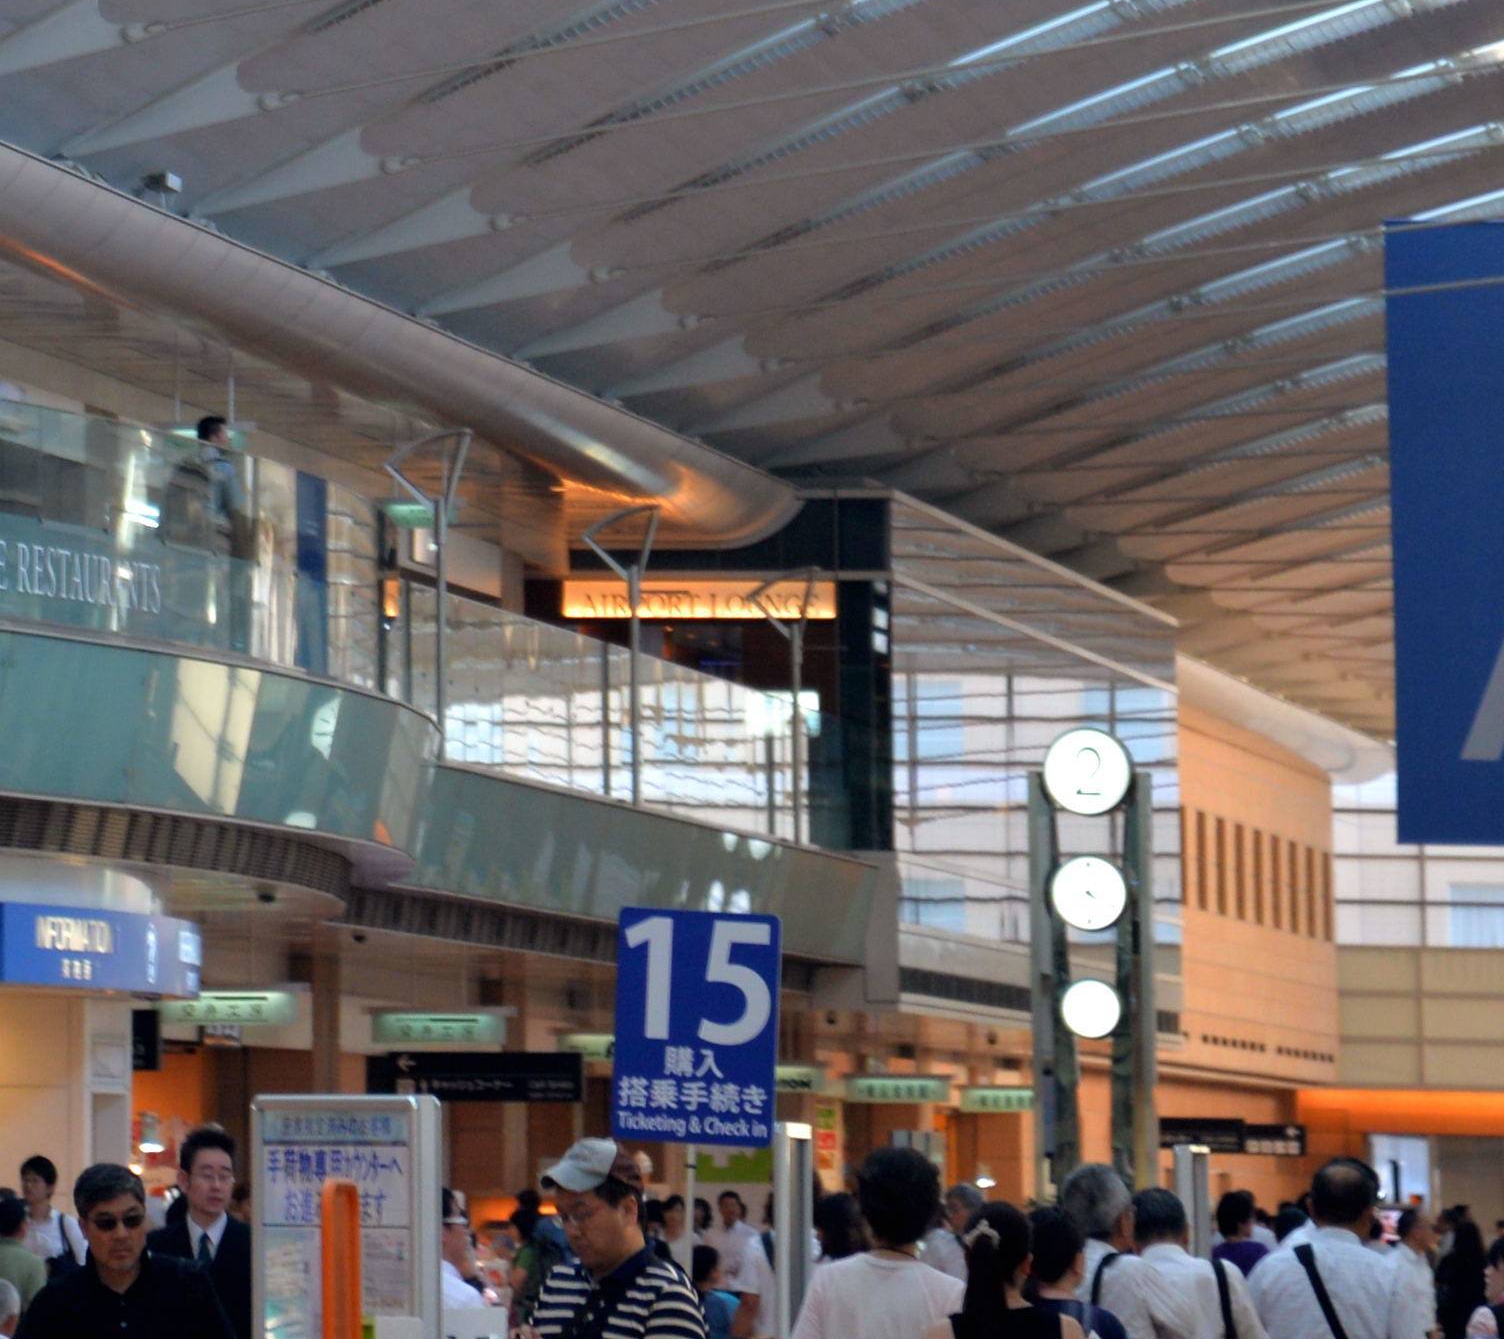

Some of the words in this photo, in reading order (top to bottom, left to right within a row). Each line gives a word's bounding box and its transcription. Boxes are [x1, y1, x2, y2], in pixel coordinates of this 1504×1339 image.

[1076, 747, 1102, 796] 2
[624, 917, 772, 1046] 15
[664, 1045, 724, 1079] 購入
[618, 1075, 768, 1115] 搭乗手続き
[617, 1110, 687, 1137] Ticketing
[689, 1116, 701, 1133] &
[704, 1117, 749, 1137] Check
[752, 1124, 768, 1138] in
